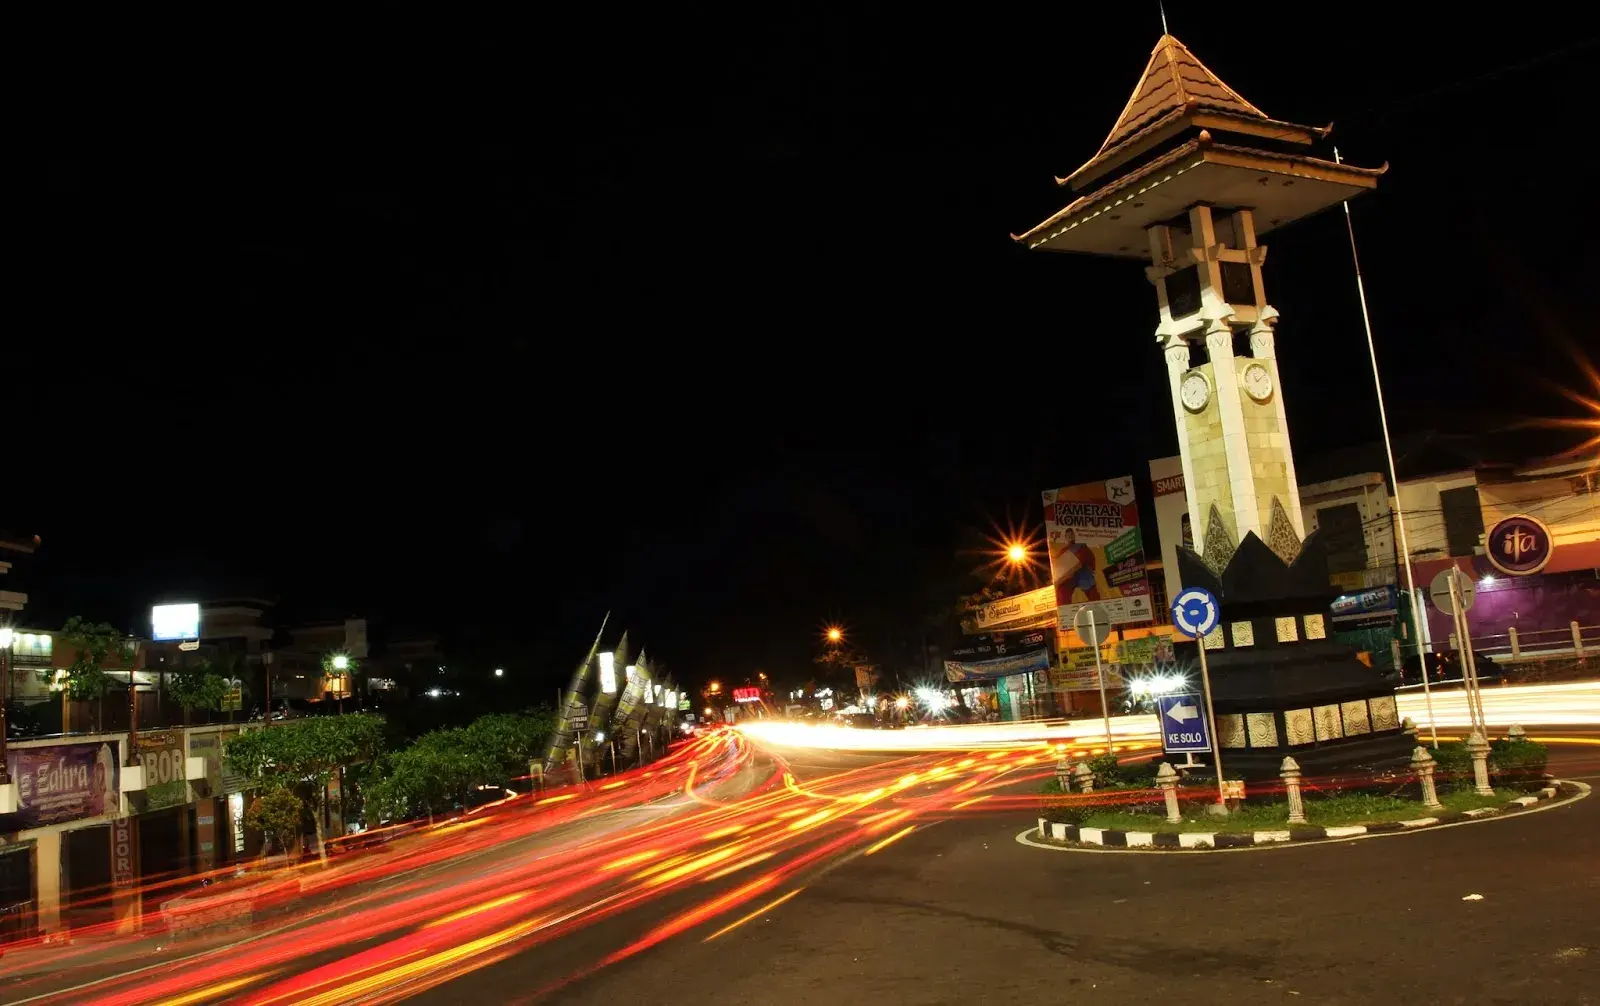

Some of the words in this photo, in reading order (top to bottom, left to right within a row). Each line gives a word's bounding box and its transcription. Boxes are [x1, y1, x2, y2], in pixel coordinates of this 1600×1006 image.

[1054, 502, 1121, 517] PAMERAN
[1055, 514, 1123, 528] KOMPUTER
[1502, 526, 1537, 563] ita
[989, 599, 1021, 619] Syawalan
[996, 643, 1007, 655] 16
[1169, 733, 1180, 744] KE
[1181, 732, 1202, 744] SOLO
[36, 756, 88, 794] Zahra
